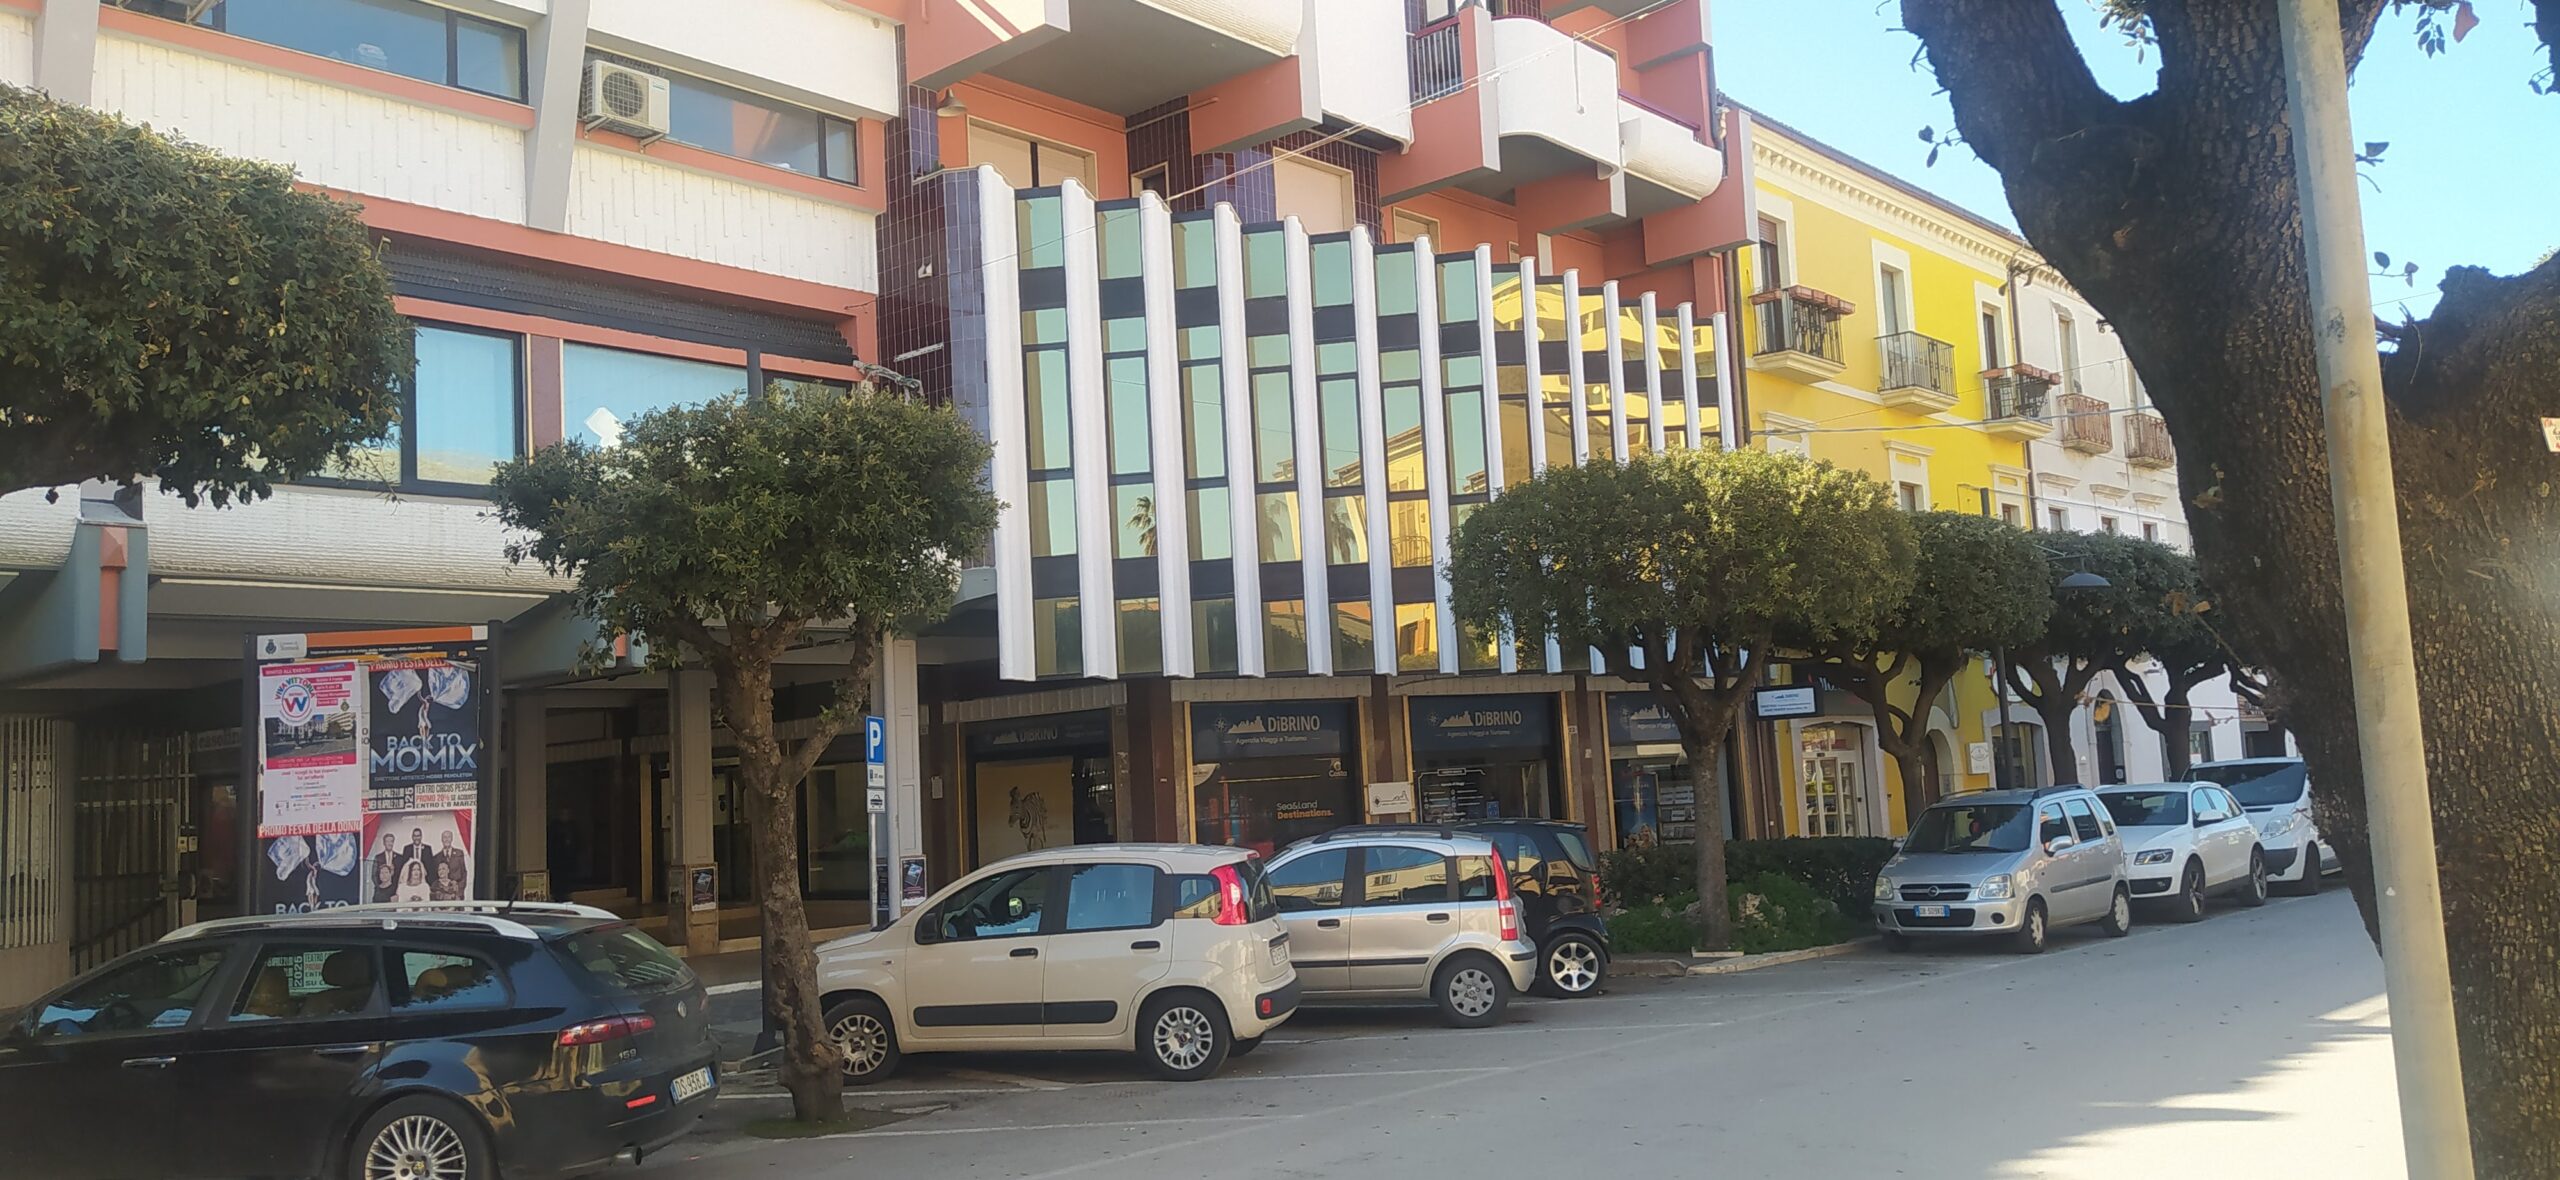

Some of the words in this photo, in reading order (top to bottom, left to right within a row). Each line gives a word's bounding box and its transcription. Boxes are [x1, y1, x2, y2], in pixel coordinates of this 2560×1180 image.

[425, 658, 449, 668] DELL
[1267, 715, 1321, 732] DiBRINO
[1475, 710, 1521, 727] DiBRINO
[387, 735, 433, 751] BACK
[437, 733, 461, 748] TO
[869, 721, 881, 760] P
[1235, 737, 1260, 746] Agenzia
[1261, 736, 1278, 744] Viaggi
[370, 743, 477, 774] MOMIX
[1328, 770, 1348, 778] Costa
[416, 784, 435, 794] TEATRO
[436, 783, 454, 793] CIRCUS
[404, 787, 414, 810] 025
[1277, 809, 1335, 820] Destinations.
[259, 825, 288, 838] PROMO
[289, 823, 313, 836] FESTA
[314, 821, 337, 834] DELLA
[338, 819, 361, 832] DONN
[294, 956, 303, 987] 2025
[618, 1048, 637, 1059] 159
